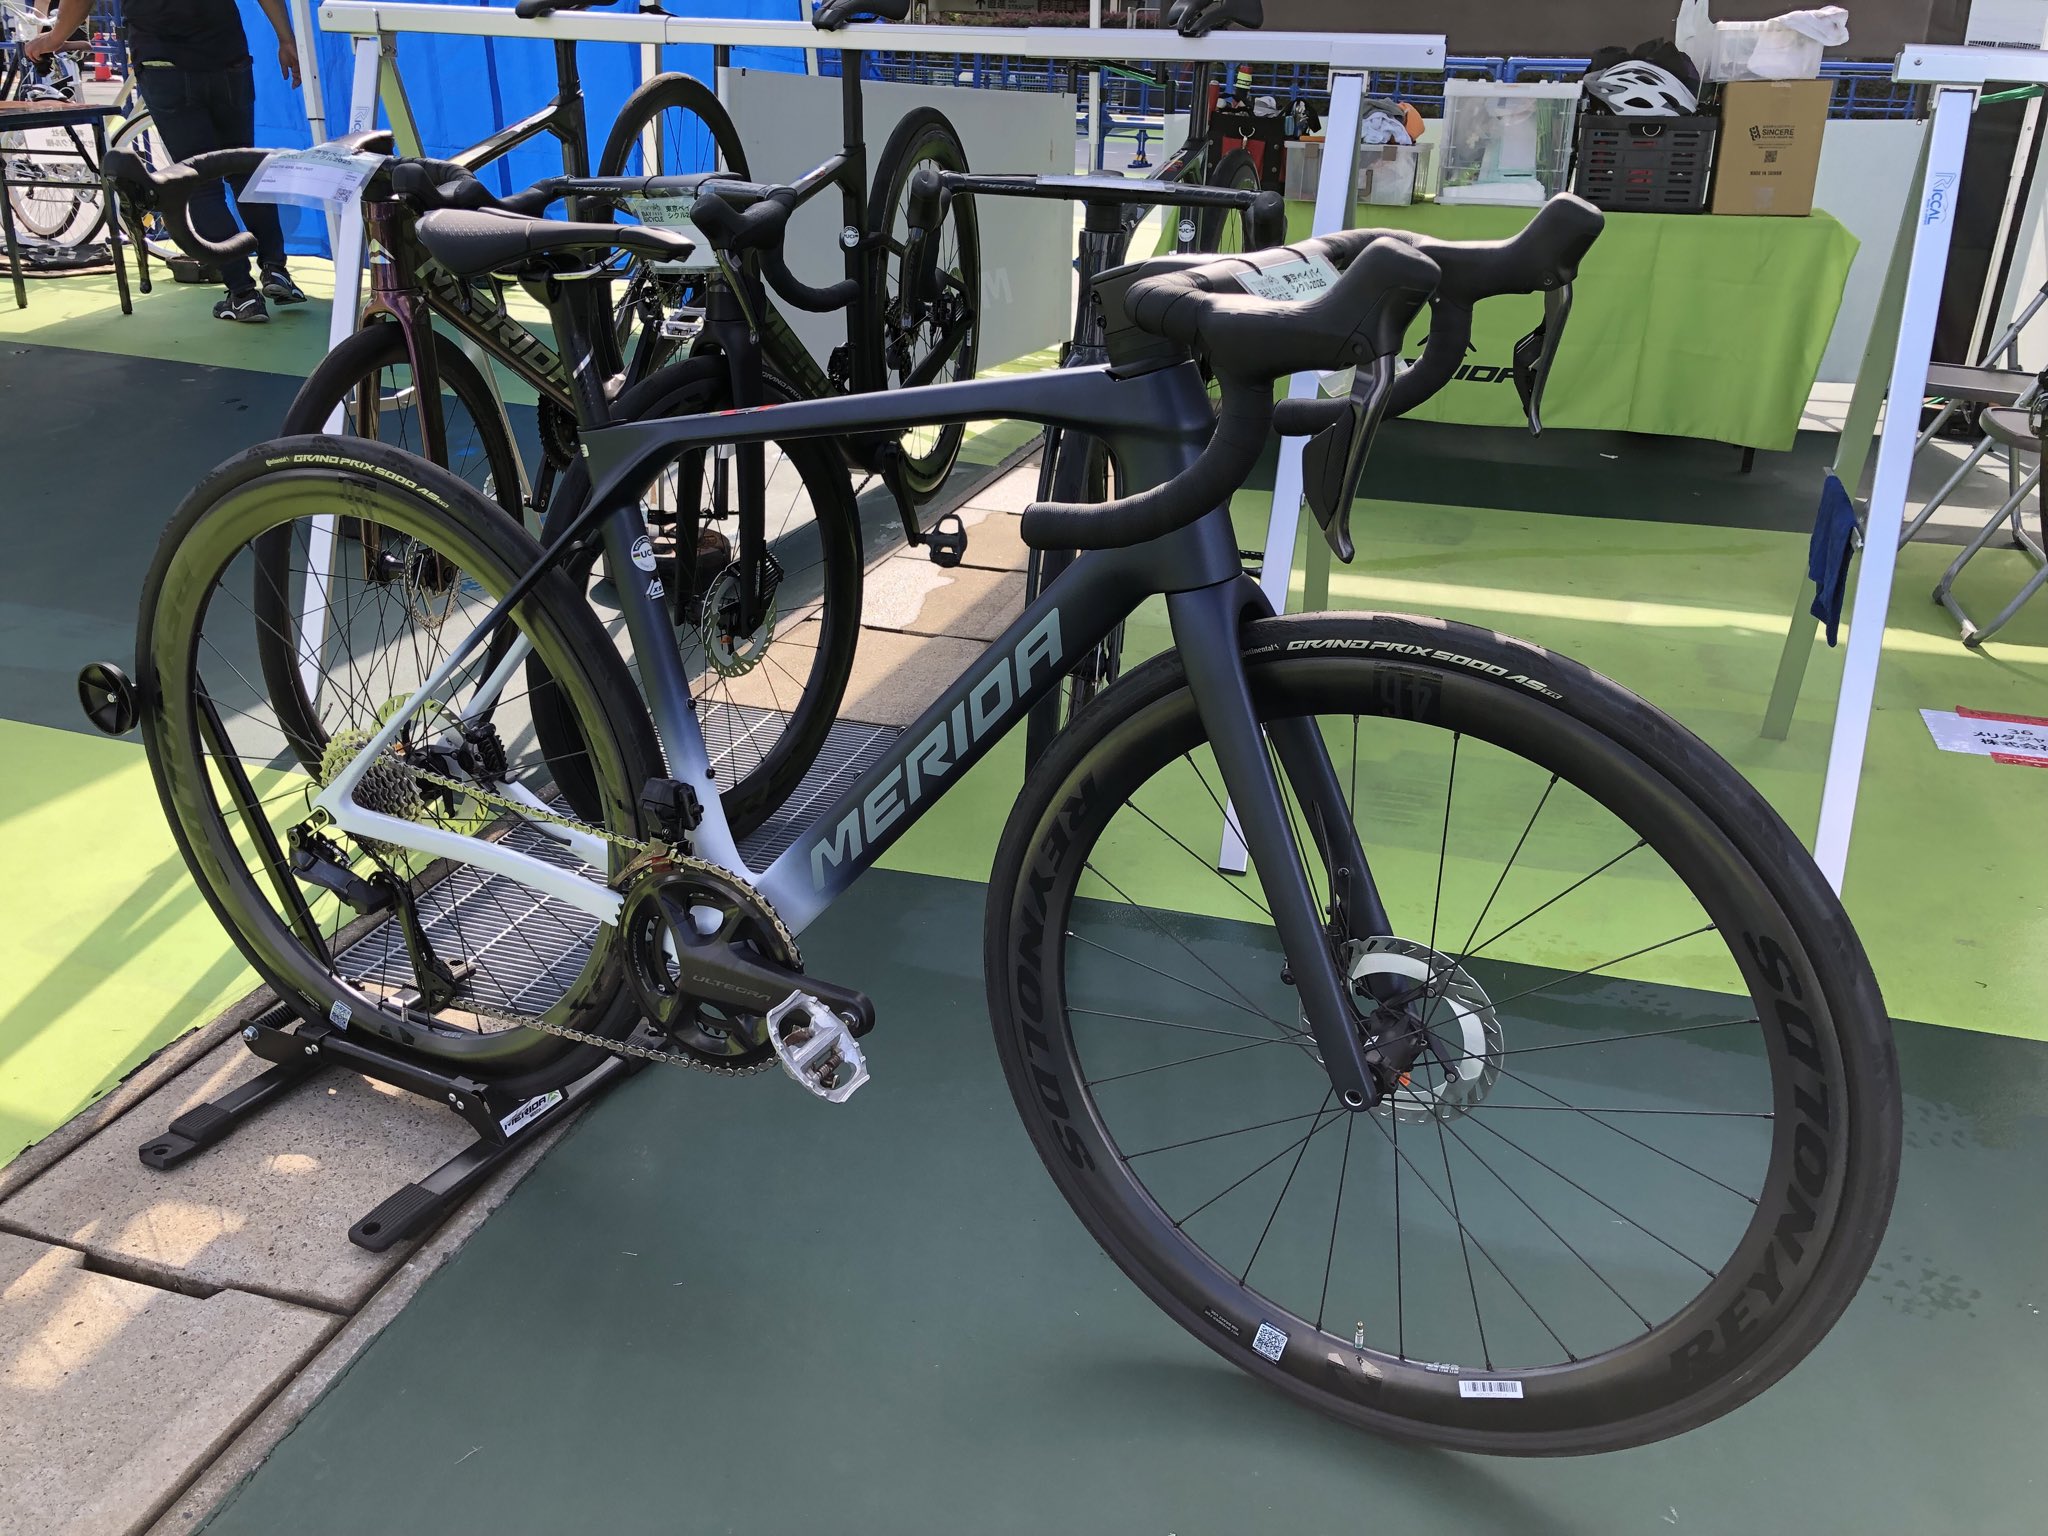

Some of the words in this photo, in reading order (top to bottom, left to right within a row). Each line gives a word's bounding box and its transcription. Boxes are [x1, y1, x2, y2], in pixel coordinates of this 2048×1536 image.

[1762, 128, 1795, 136] SINCERE
[293, 454, 340, 464] GRAND
[340, 457, 376, 473] PRIX
[374, 467, 418, 489] 5000
[1286, 639, 1370, 651] GRAND
[1368, 640, 1428, 658] PRIX
[1430, 651, 1509, 678] 5000
[810, 607, 1064, 897] MERIDA
[692, 974, 772, 1001] ULTEGRA
[1017, 771, 1098, 1173] REYNOLDS
[504, 1095, 547, 1131] MERIDA
[1669, 930, 1832, 1382] REYNOLDS
